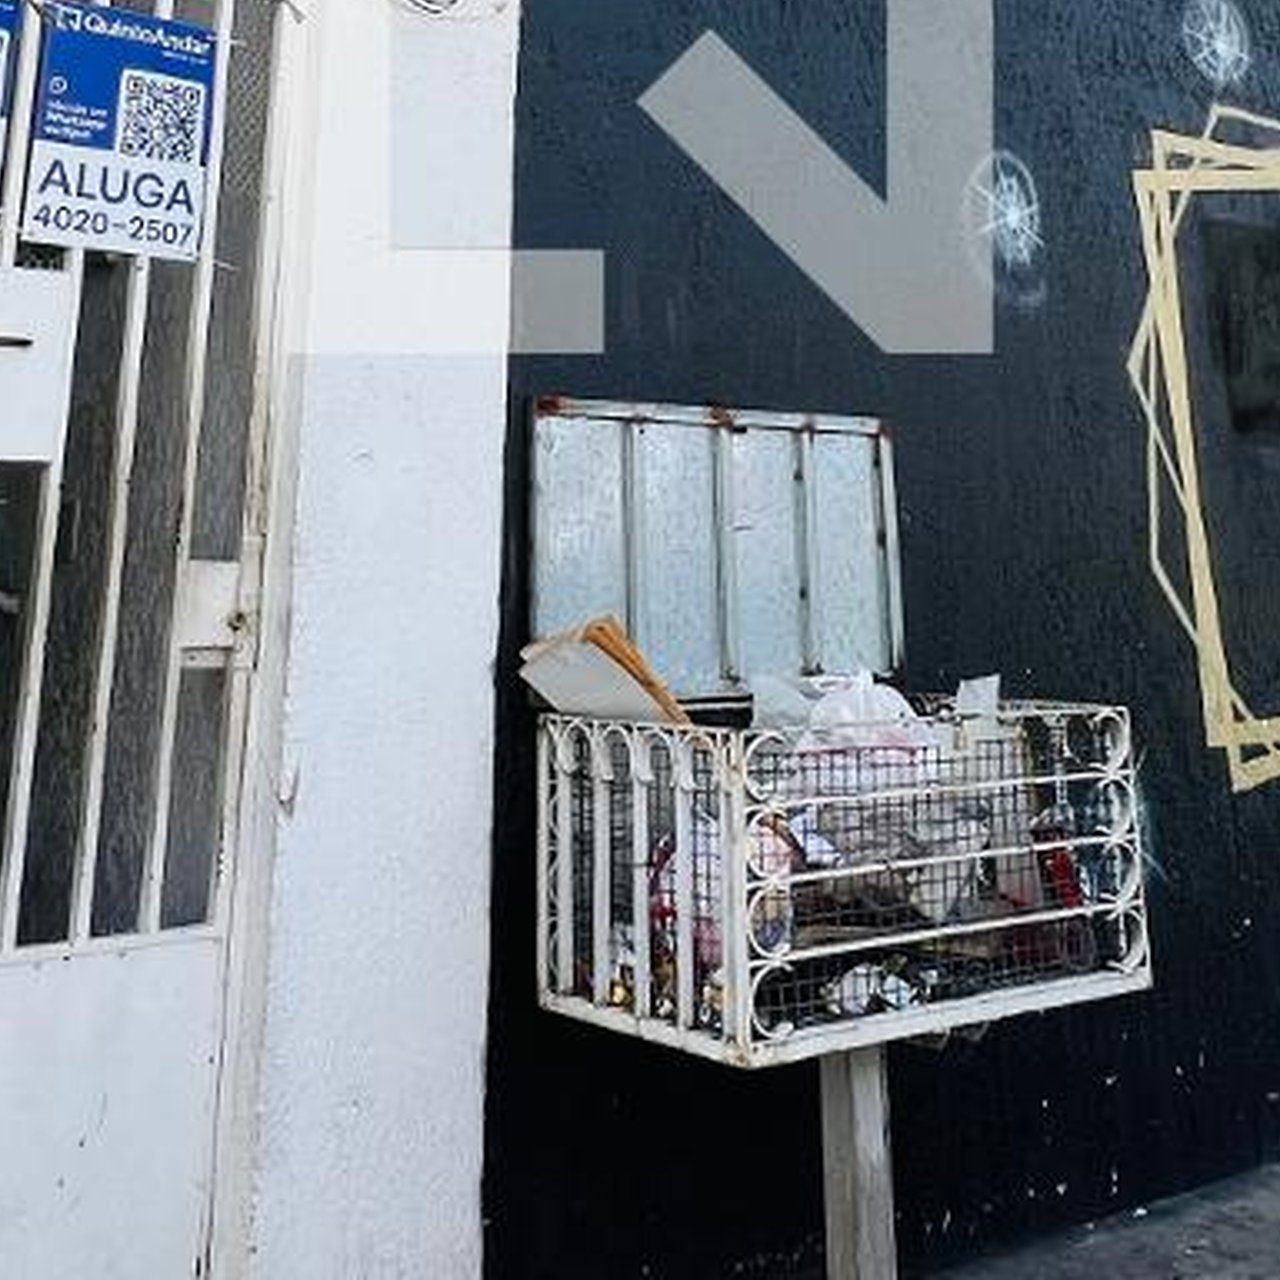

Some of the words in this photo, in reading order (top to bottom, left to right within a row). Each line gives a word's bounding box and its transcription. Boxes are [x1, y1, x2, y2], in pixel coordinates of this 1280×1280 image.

[84, 12, 211, 55] QuintoAndar
[38, 159, 194, 215] ALUGA
[32, 205, 194, 248] 4020-2507
